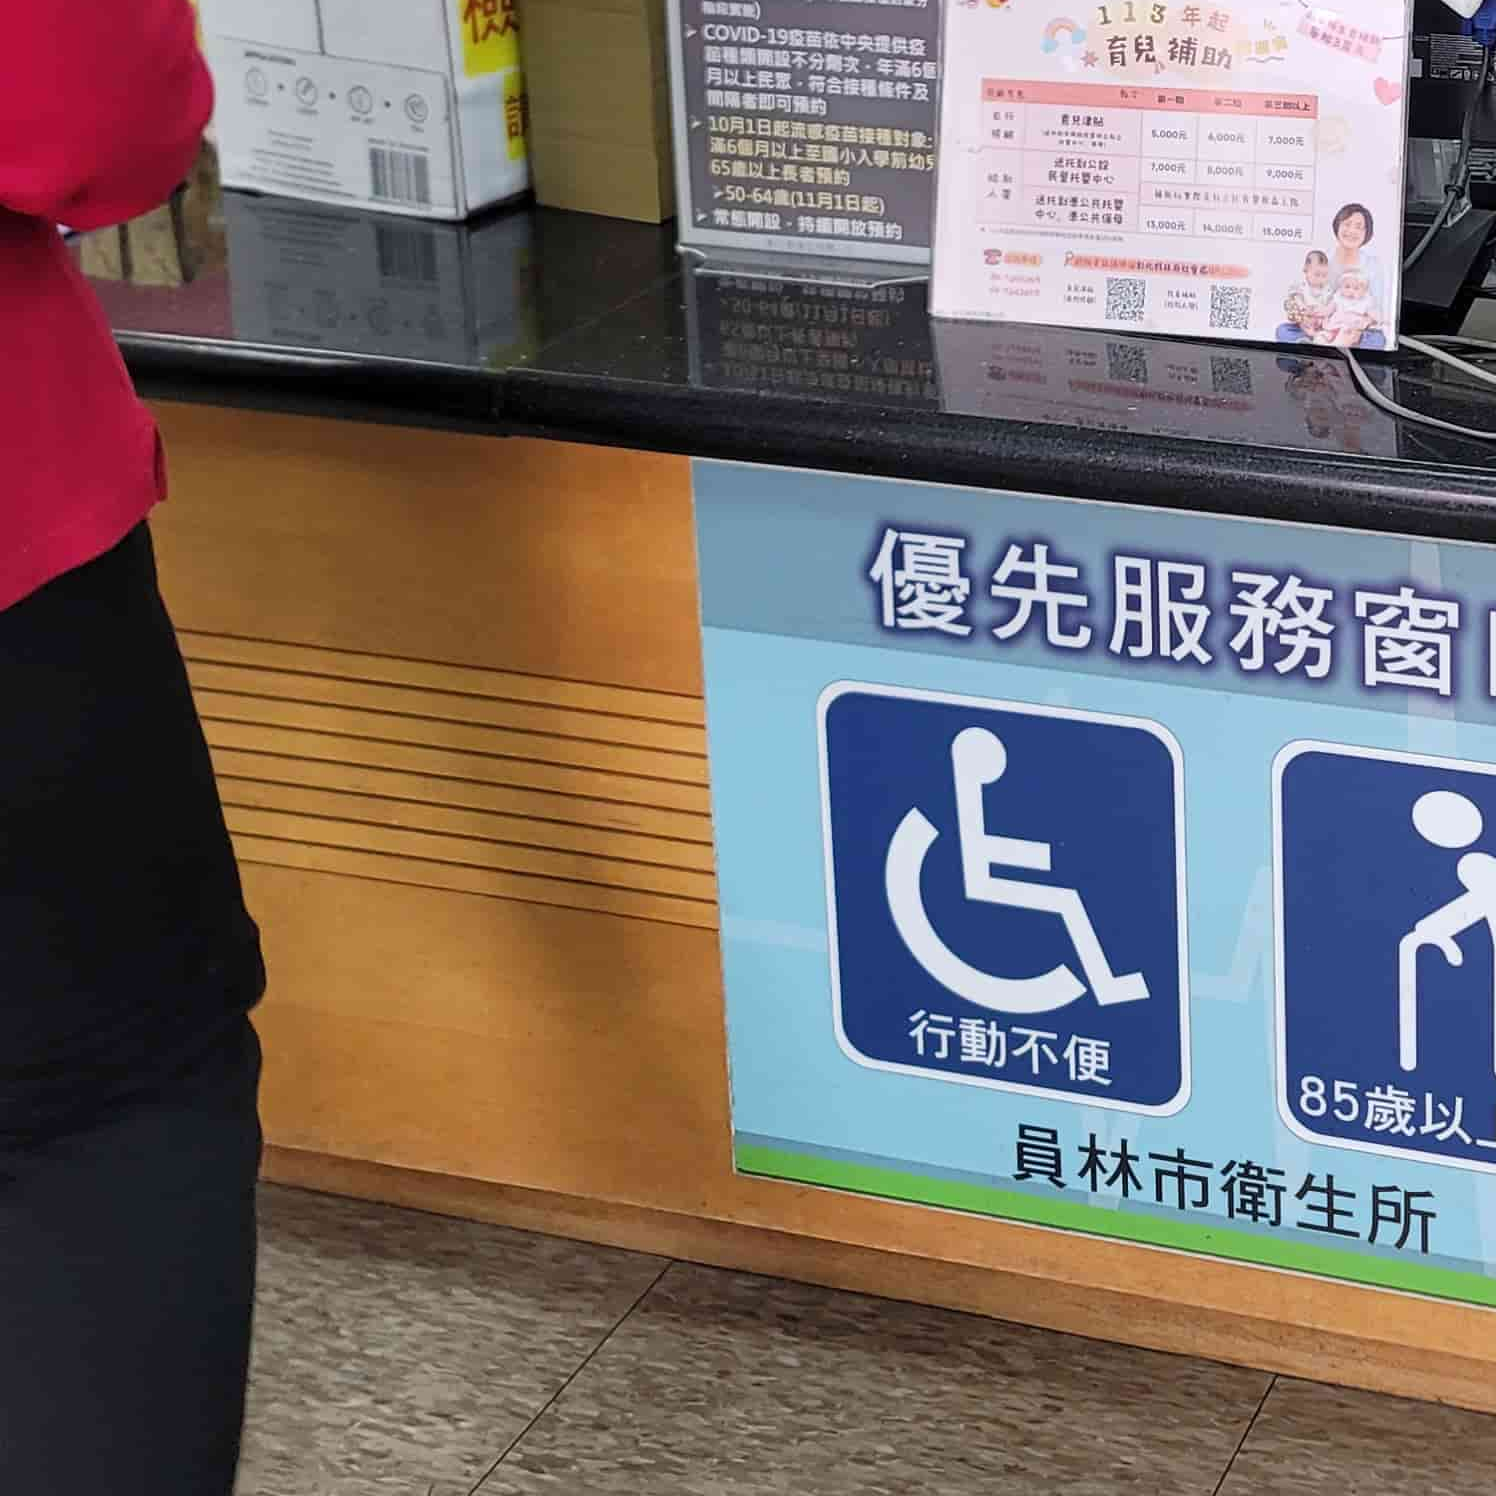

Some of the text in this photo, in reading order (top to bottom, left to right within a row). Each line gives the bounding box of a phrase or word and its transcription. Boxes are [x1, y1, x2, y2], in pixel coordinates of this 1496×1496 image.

[1106, 34, 1232, 70] 育兒補助
[711, 160, 850, 186] 65歲以上長者預約
[726, 185, 885, 216] 50-64歲(11月1日起)
[908, 1009, 1112, 1086] 行動不便
[1013, 1123, 1439, 1256] 員林市衛生所
